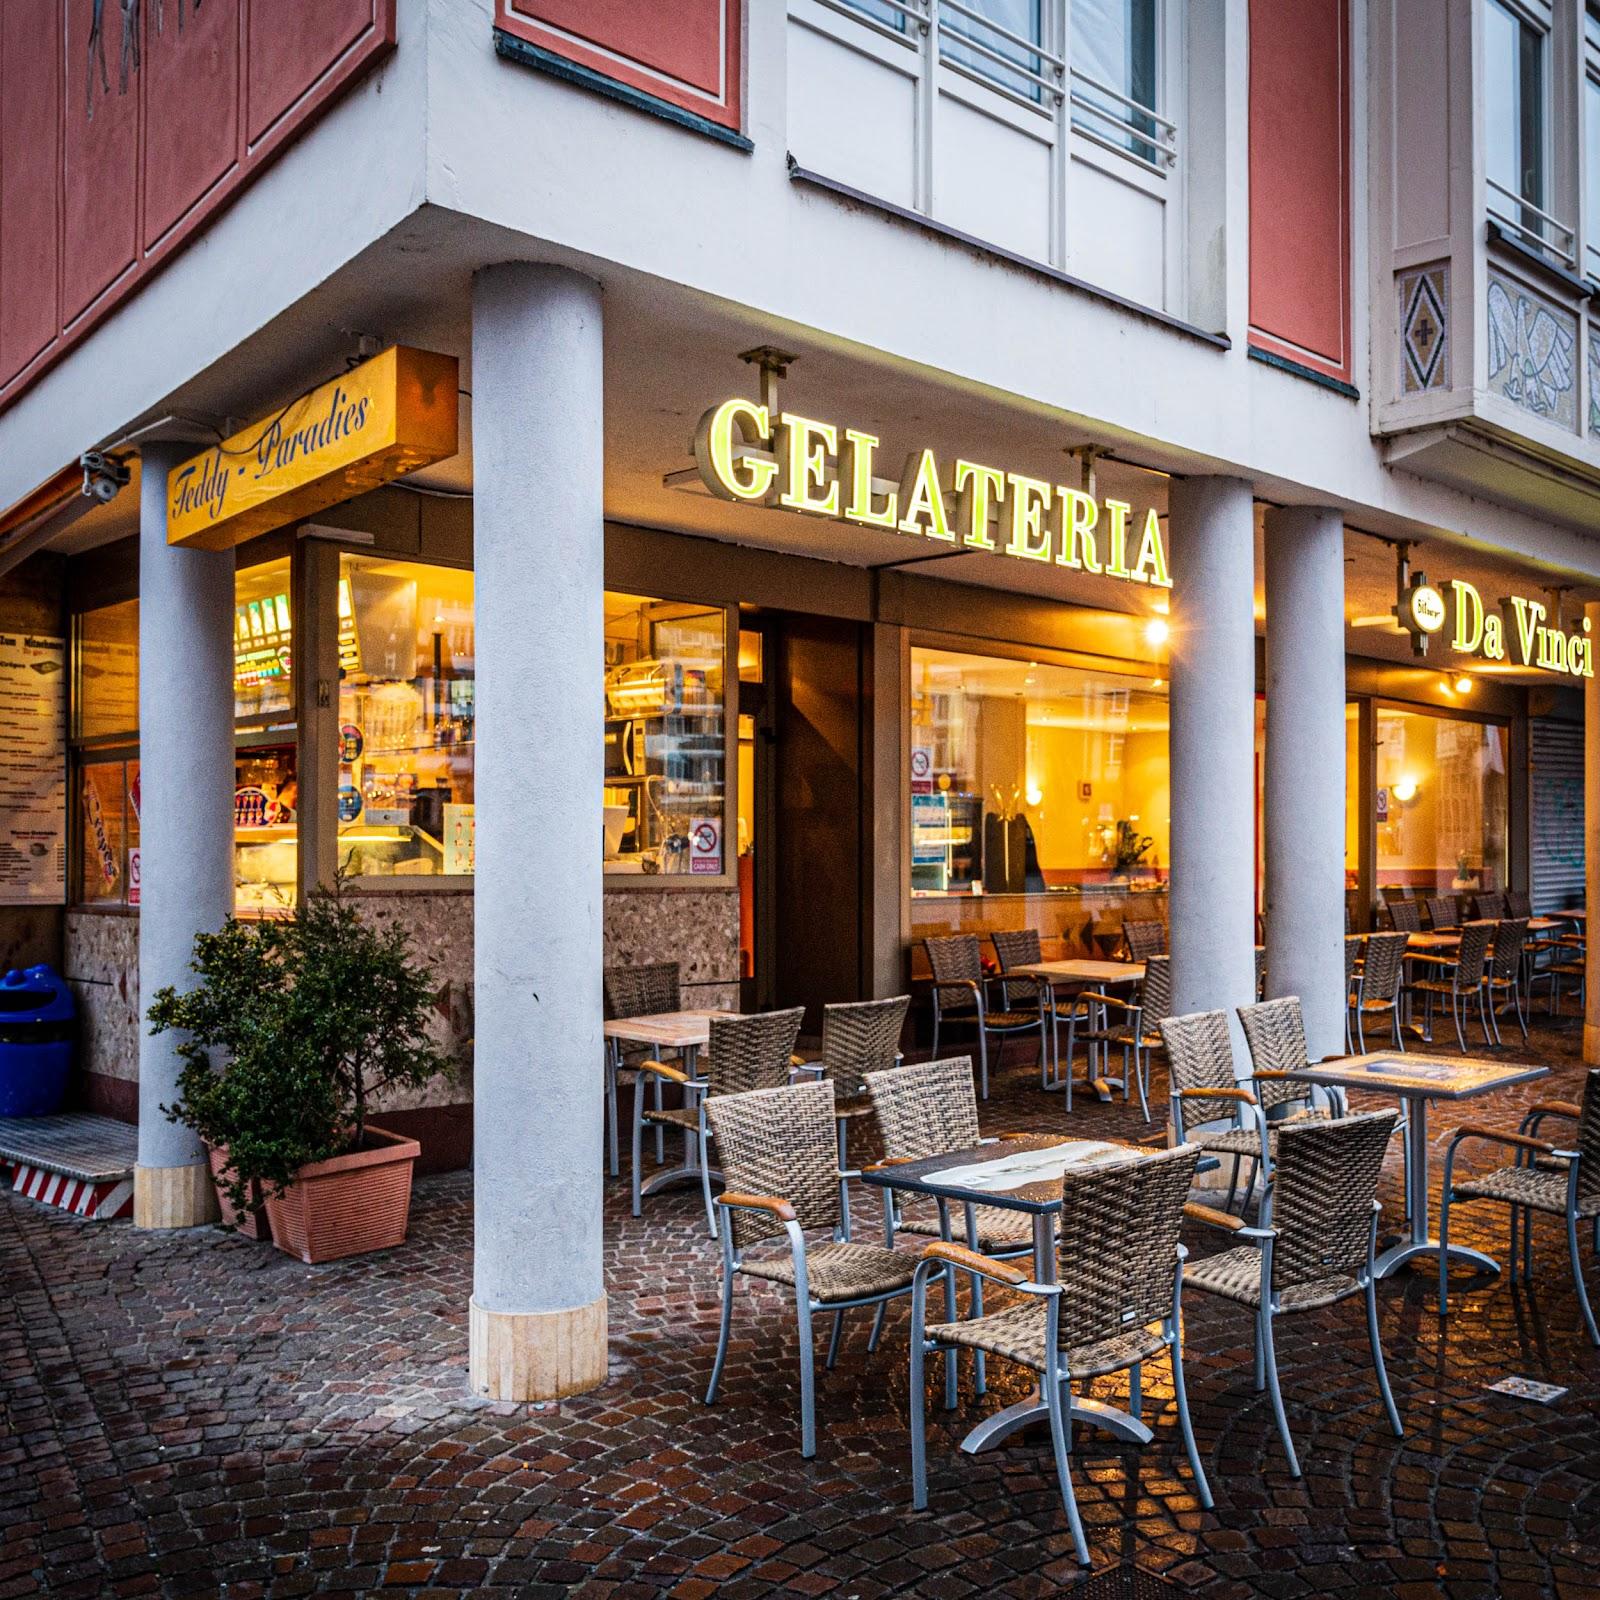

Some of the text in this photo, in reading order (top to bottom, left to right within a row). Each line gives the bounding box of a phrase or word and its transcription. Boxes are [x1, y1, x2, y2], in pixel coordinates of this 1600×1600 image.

[172, 445, 229, 520] Teddy
[254, 387, 368, 480] Paradies
[709, 398, 1174, 588] GELATERIA
[1451, 579, 1594, 678] Da Vinci
